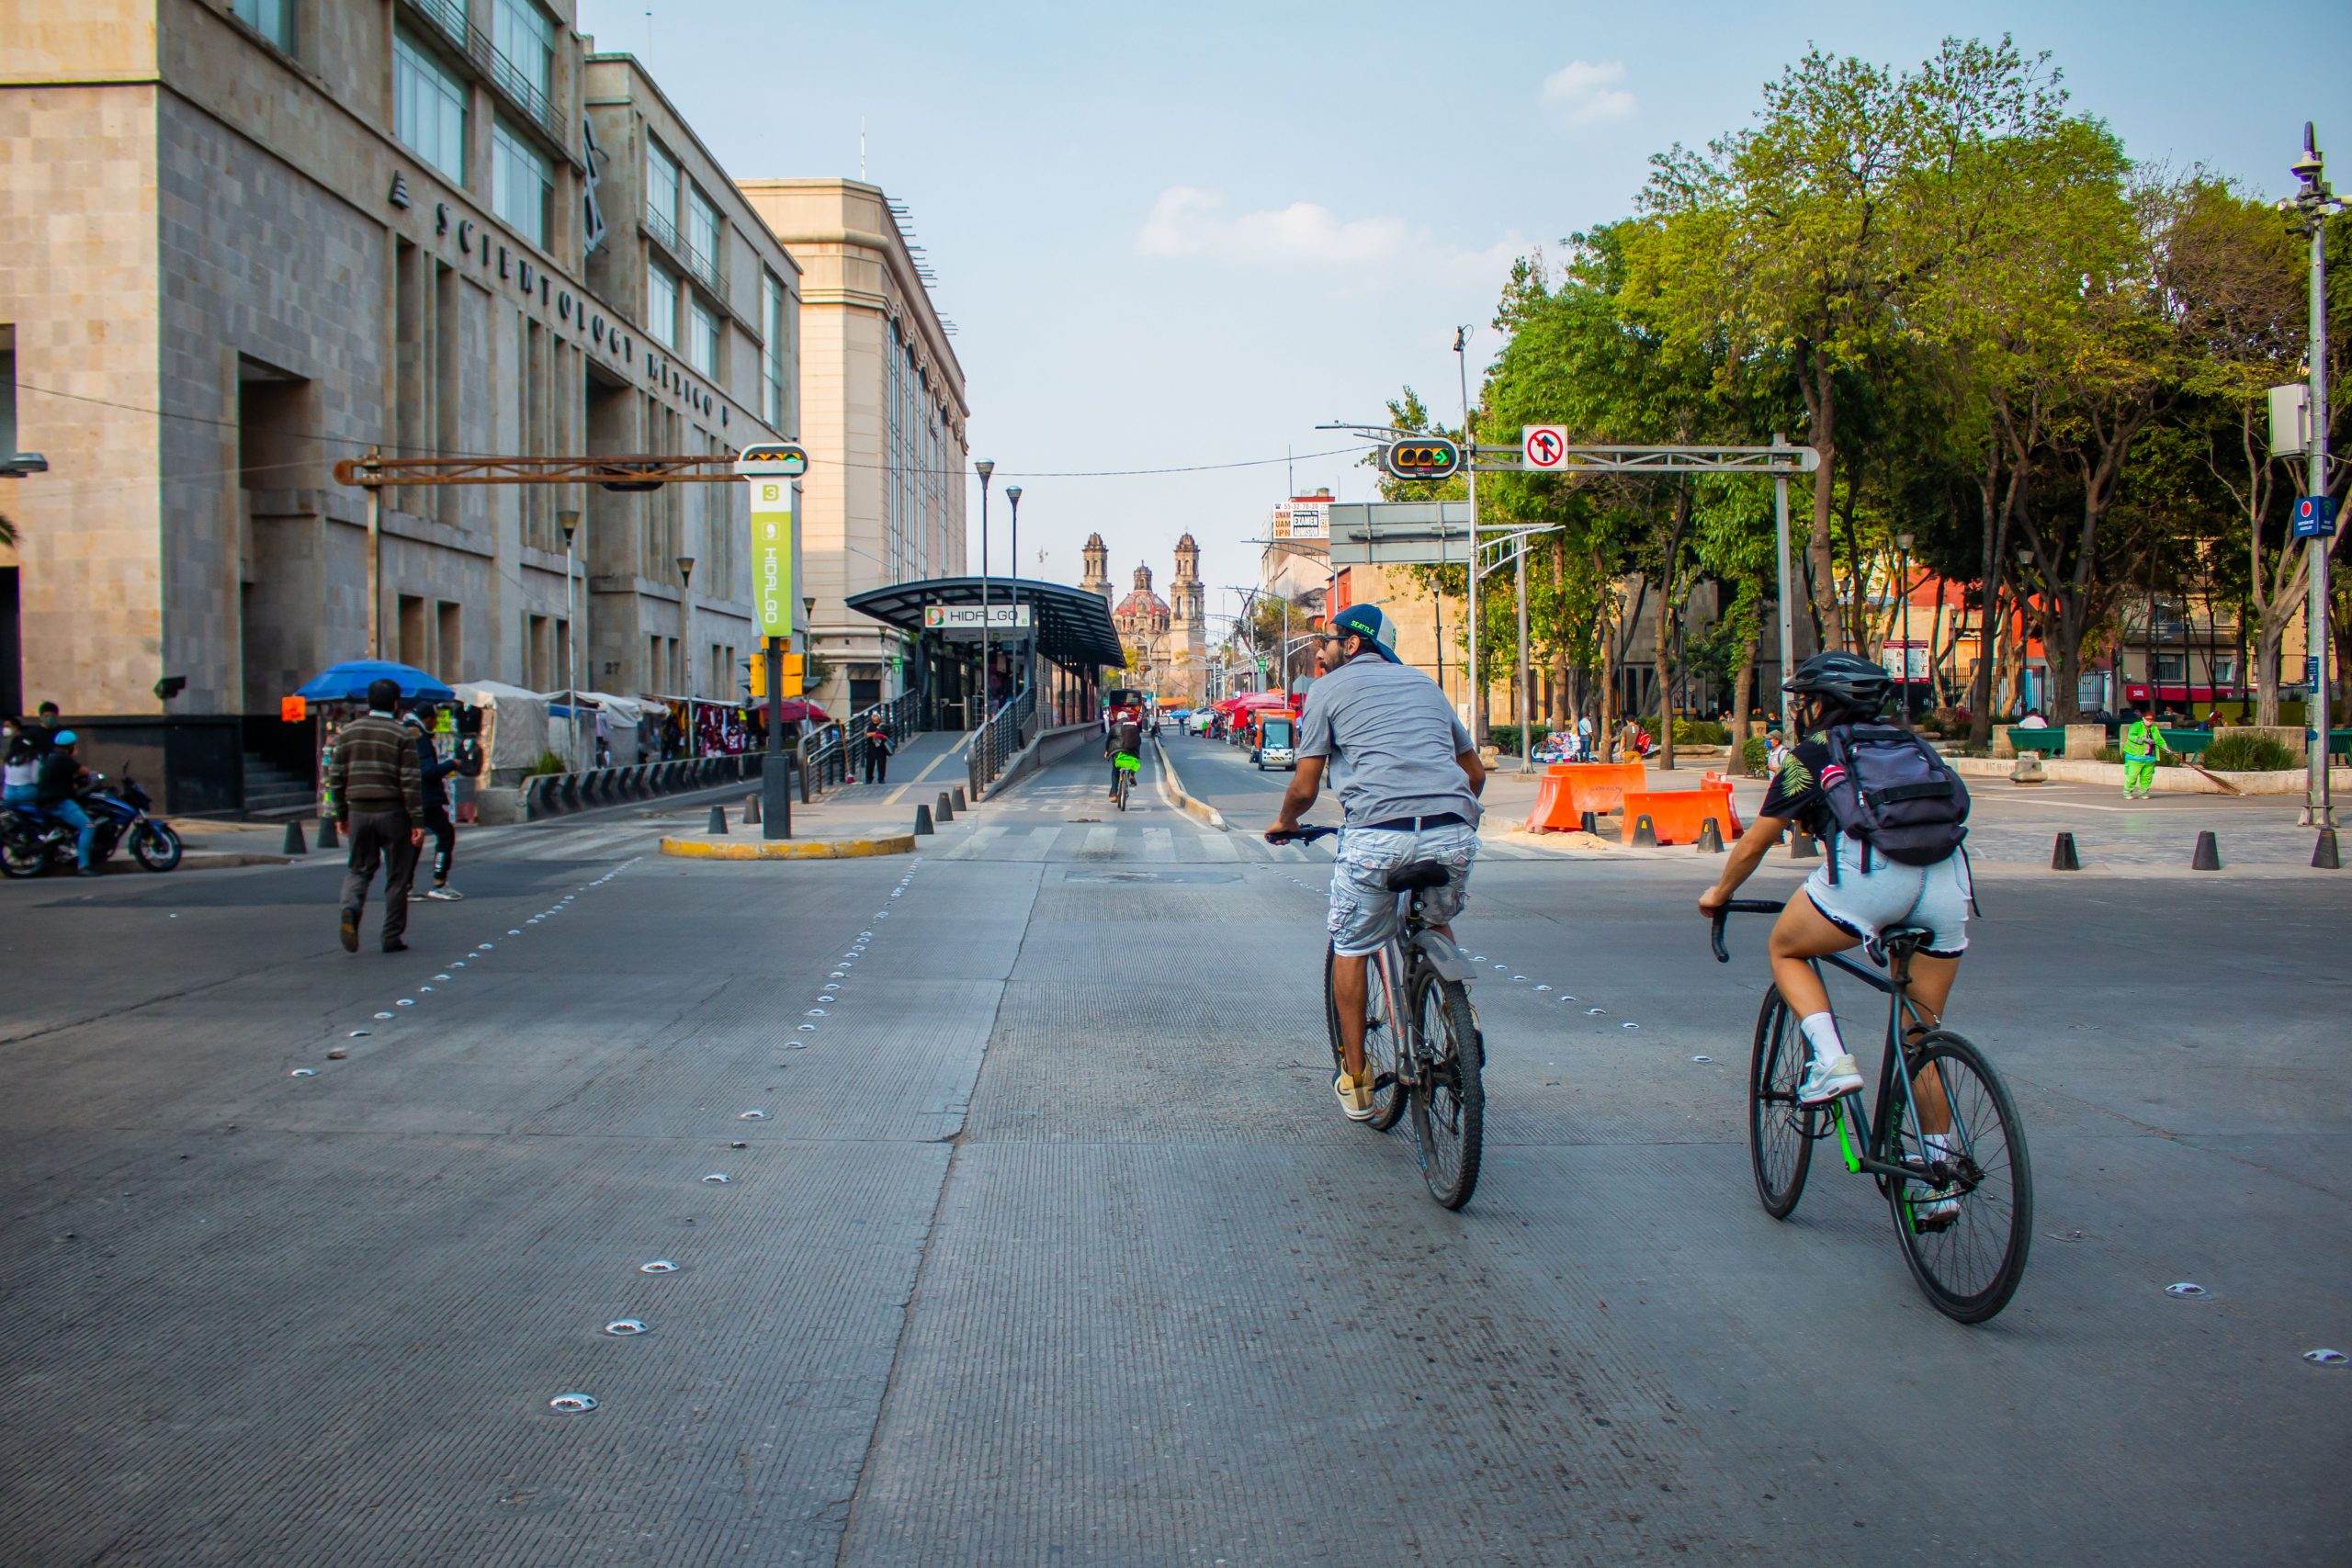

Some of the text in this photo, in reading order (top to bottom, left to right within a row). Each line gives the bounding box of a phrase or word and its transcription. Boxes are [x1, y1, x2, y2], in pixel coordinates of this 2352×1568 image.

[436, 203, 633, 363] SCIENTOLOGY
[764, 547, 778, 625] HIDALGO
[950, 610, 1018, 622] HIDALGO
[1351, 620, 1375, 636] SEATTLE
[605, 661, 621, 675] 27
